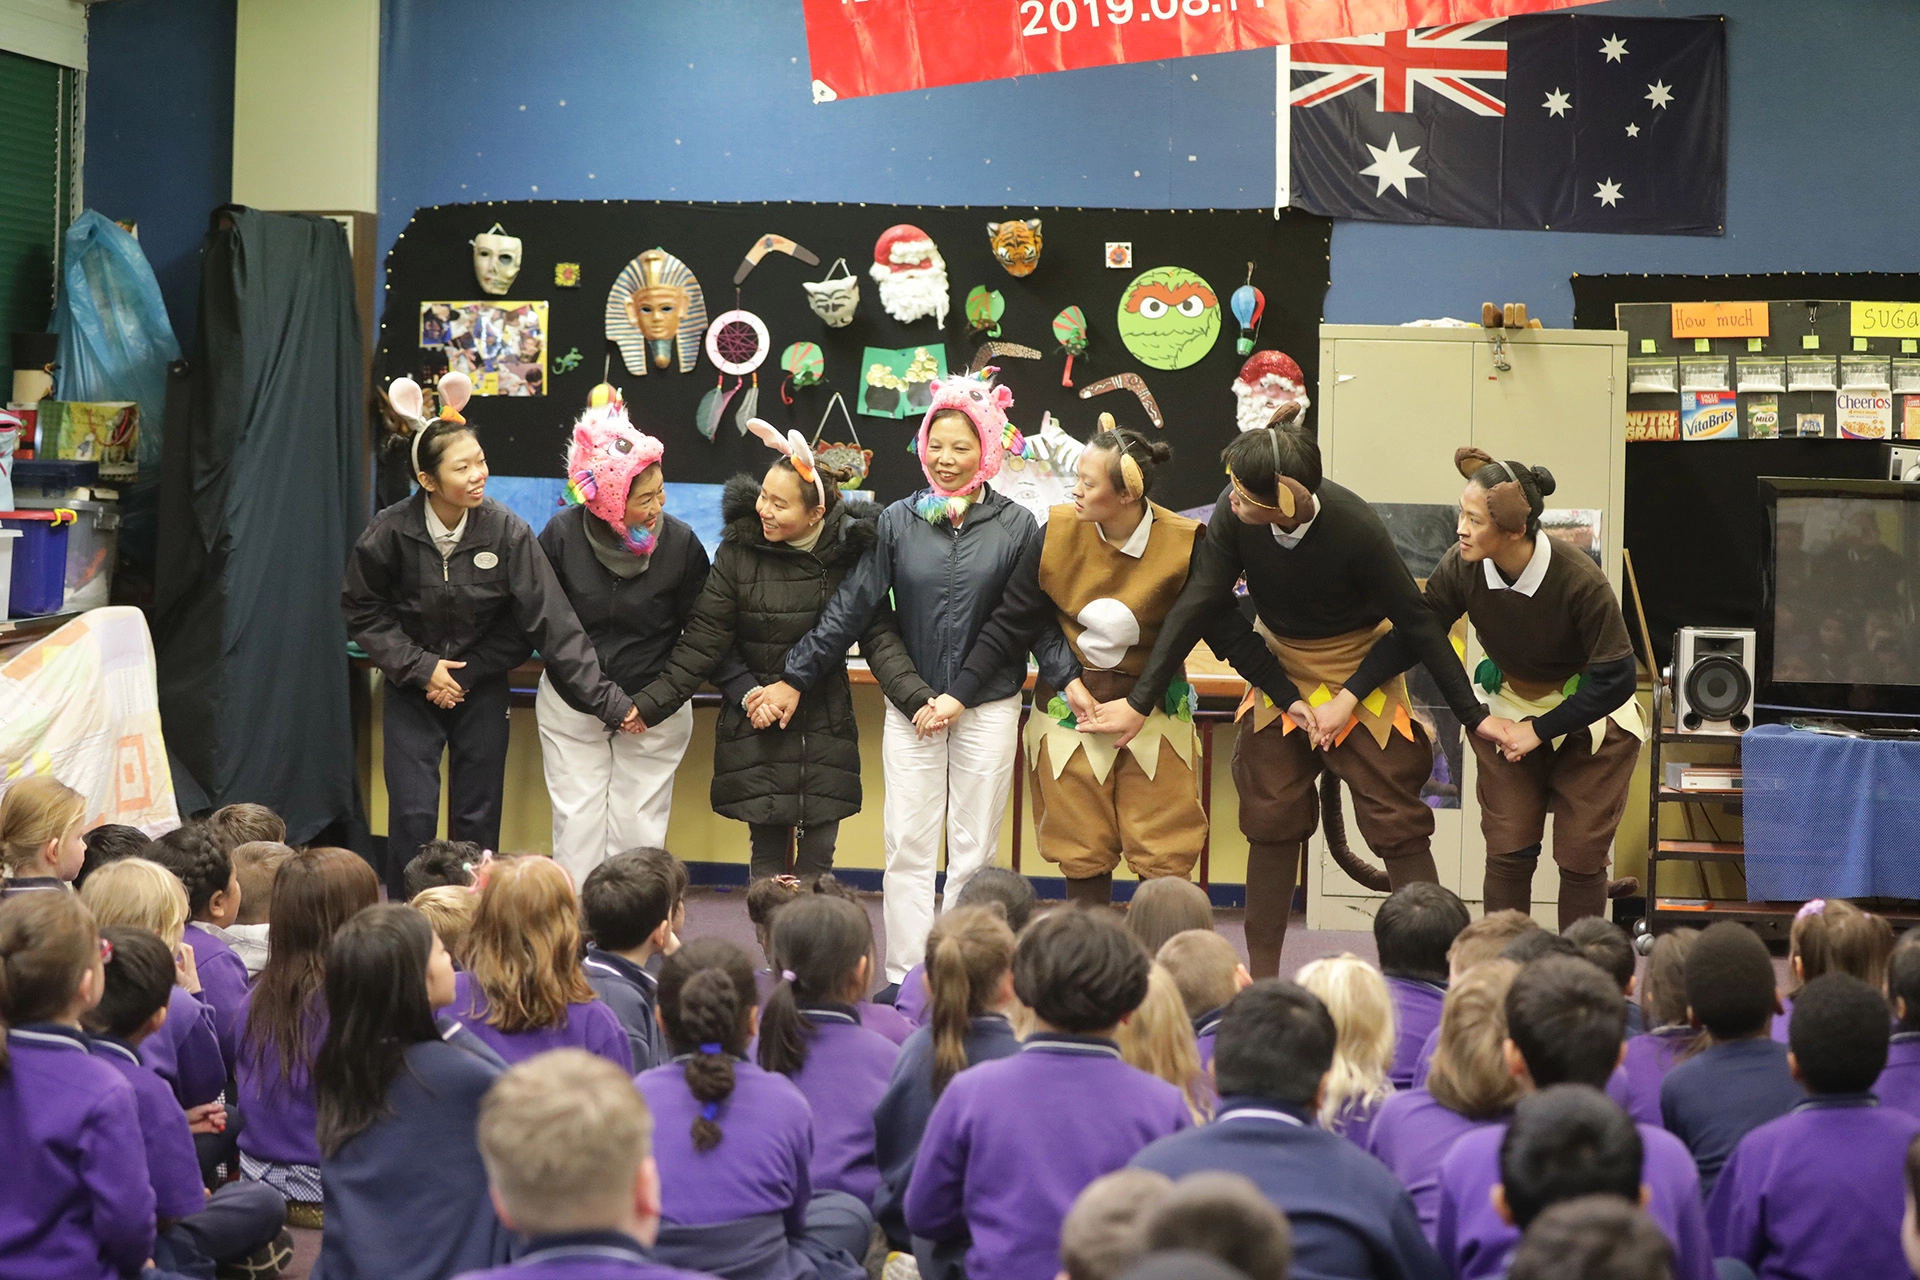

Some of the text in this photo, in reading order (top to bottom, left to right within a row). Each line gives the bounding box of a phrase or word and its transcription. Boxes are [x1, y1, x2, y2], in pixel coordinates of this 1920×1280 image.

[1676, 309, 1706, 330] How
[1837, 394, 1891, 409] Cheerios
[1685, 410, 1734, 436] VitaBrits
[1625, 425, 1676, 440] GRAIN
